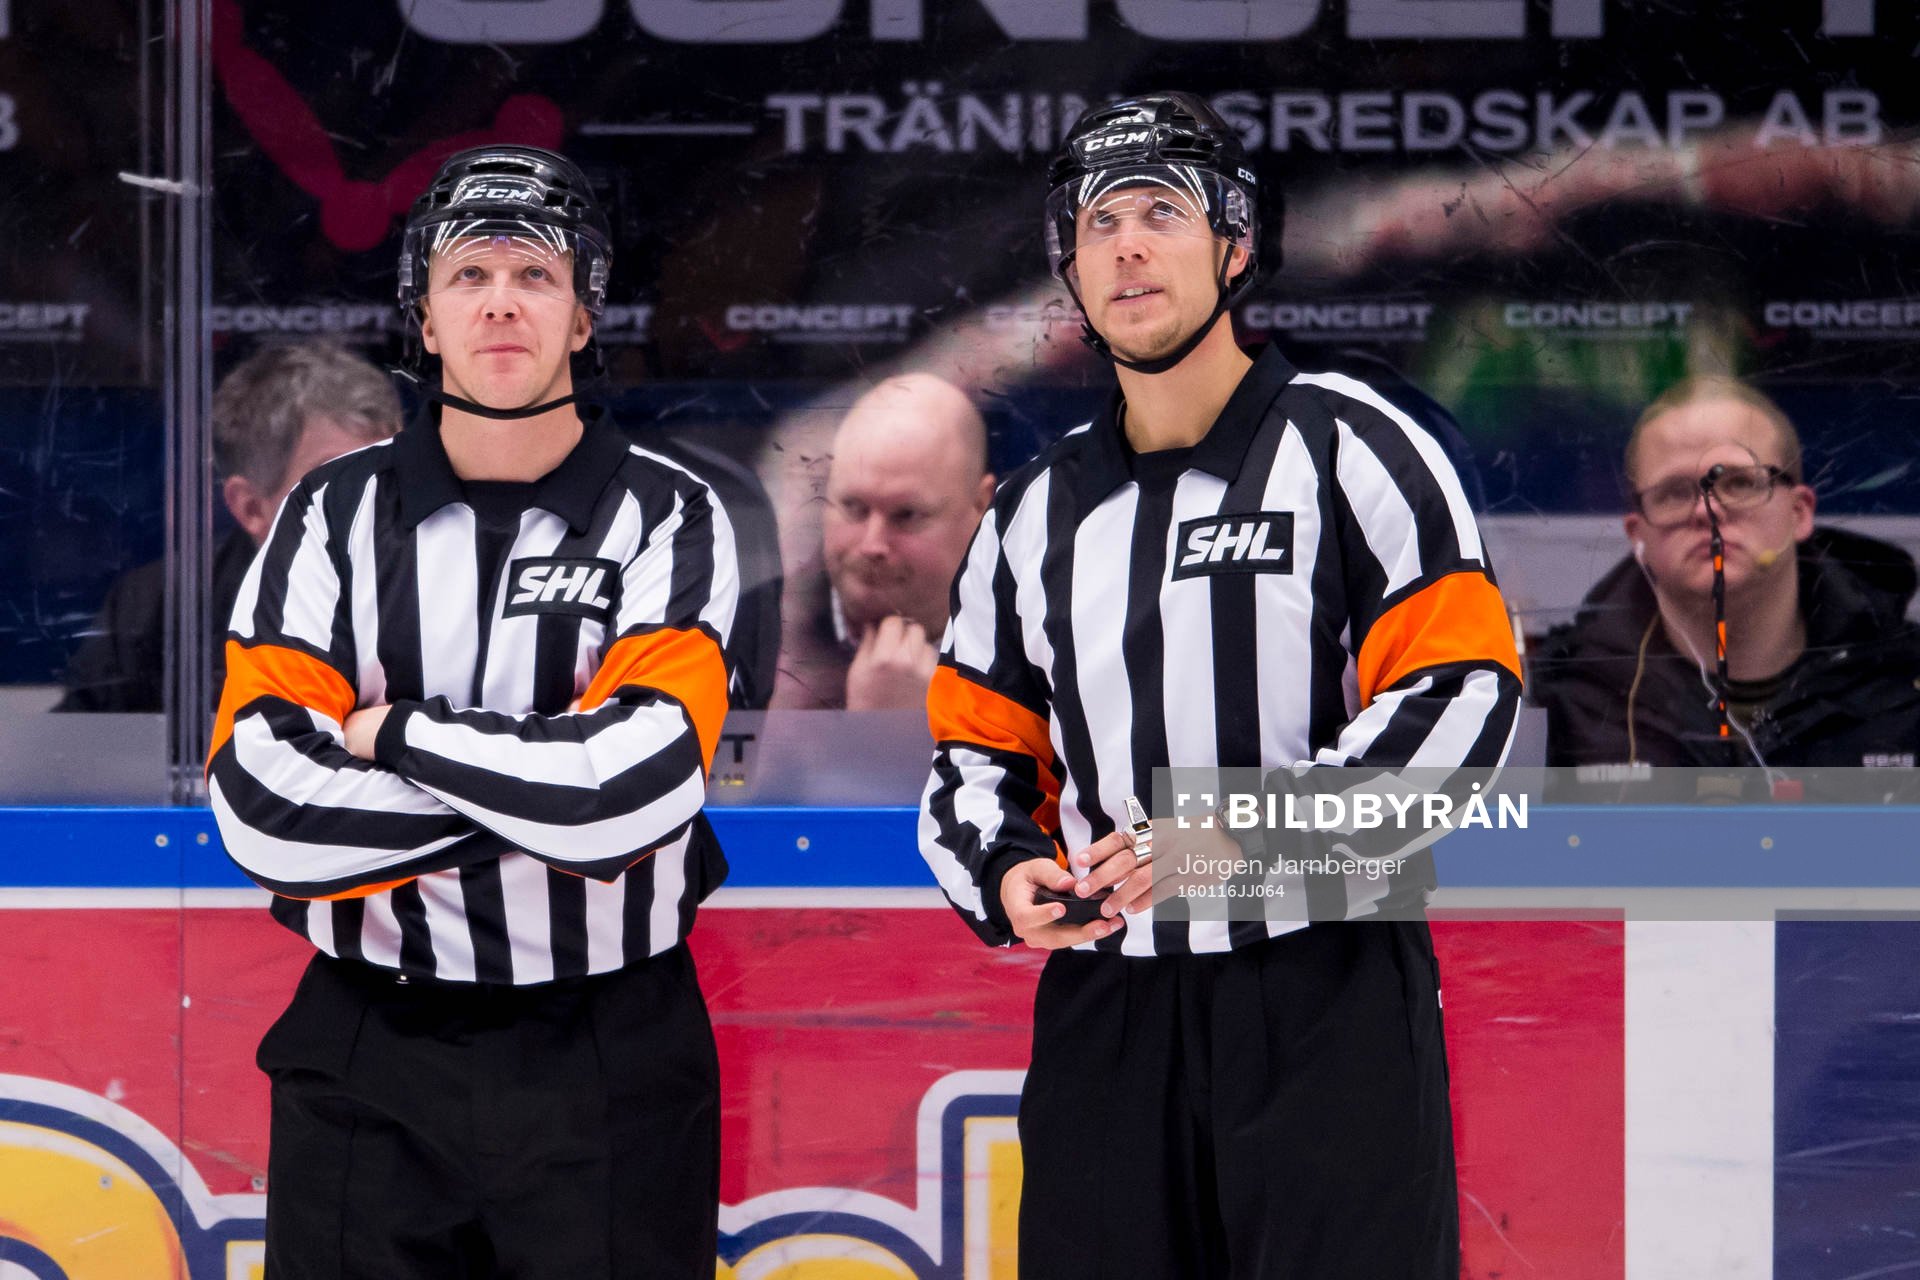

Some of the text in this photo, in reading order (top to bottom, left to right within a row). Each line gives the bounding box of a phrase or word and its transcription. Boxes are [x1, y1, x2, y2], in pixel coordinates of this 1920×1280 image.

[766, 81, 1883, 152] TRÄNISREDSKAP AB
[1085, 131, 1149, 151] CCM
[464, 188, 532, 200] CCM
[726, 304, 913, 330] CONCEPT
[1244, 304, 1433, 328] CONCEPT
[1504, 303, 1693, 327] CONCEPT
[1180, 521, 1285, 567] SHL
[510, 566, 611, 610] SHL
